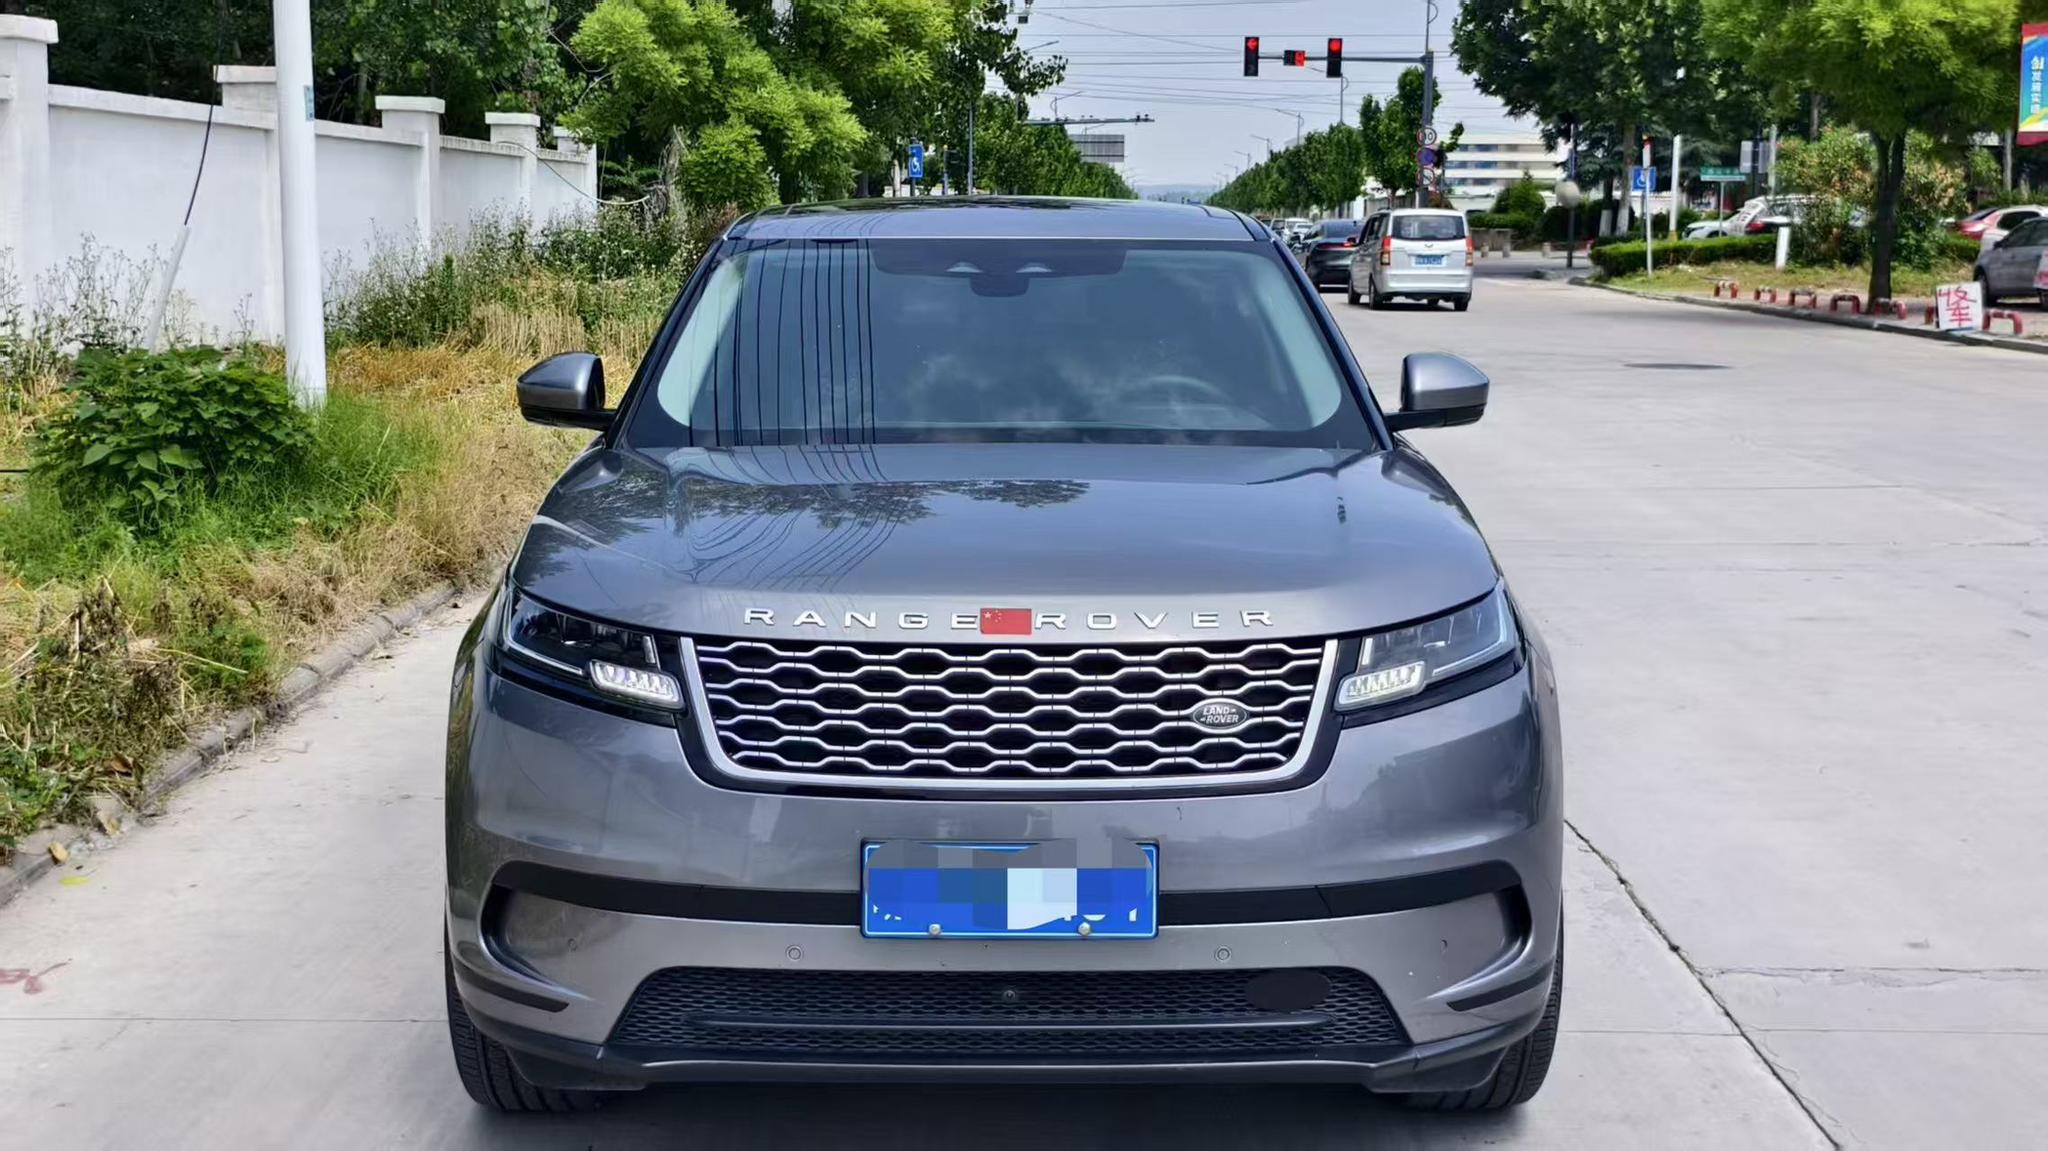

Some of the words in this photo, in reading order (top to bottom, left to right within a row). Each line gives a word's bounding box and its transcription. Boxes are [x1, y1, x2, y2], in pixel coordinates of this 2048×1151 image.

[743, 607, 979, 630] RANGE
[1034, 609, 1274, 630] ROVER
[1203, 706, 1230, 716] LAND
[1205, 714, 1240, 724] ROVER
